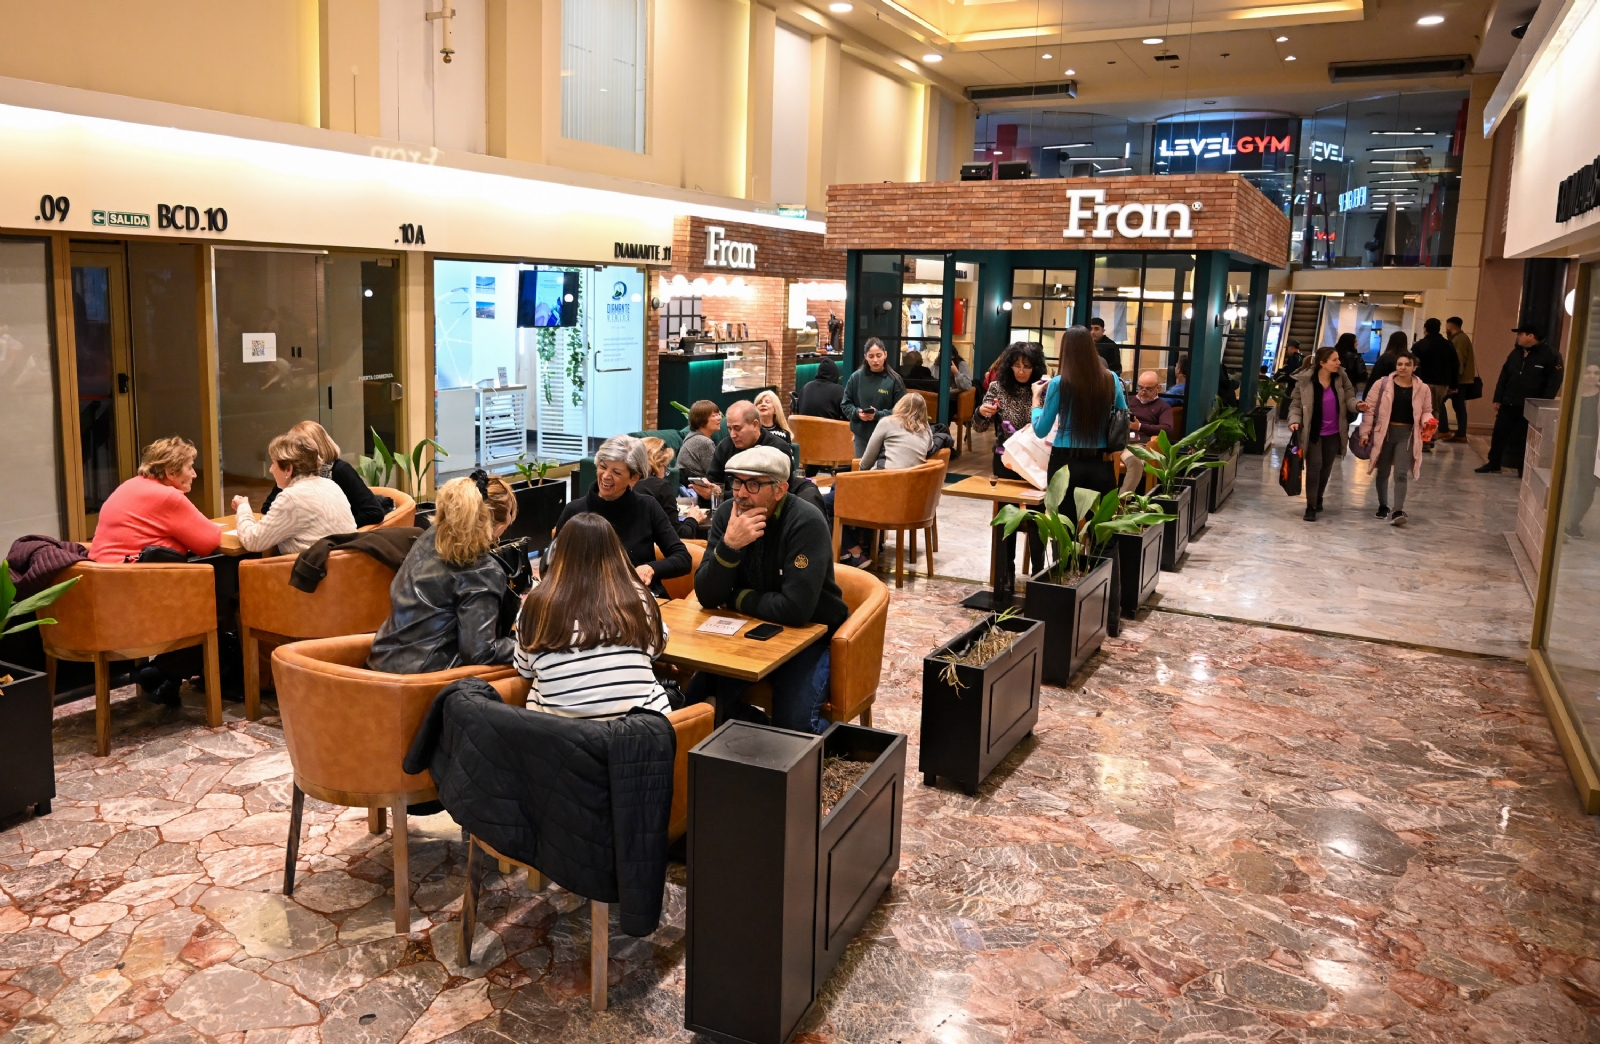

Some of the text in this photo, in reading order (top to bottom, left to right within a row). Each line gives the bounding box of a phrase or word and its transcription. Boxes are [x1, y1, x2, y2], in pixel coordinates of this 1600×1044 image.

[1160, 135, 1291, 158] LEVEL GYM
[34, 194, 71, 223] .09
[109, 213, 148, 226] SALIDA
[157, 203, 229, 232] BCD.10
[1063, 189, 1194, 238] Fran
[614, 242, 661, 260] DIAMANTE
[704, 226, 756, 269] Fran
